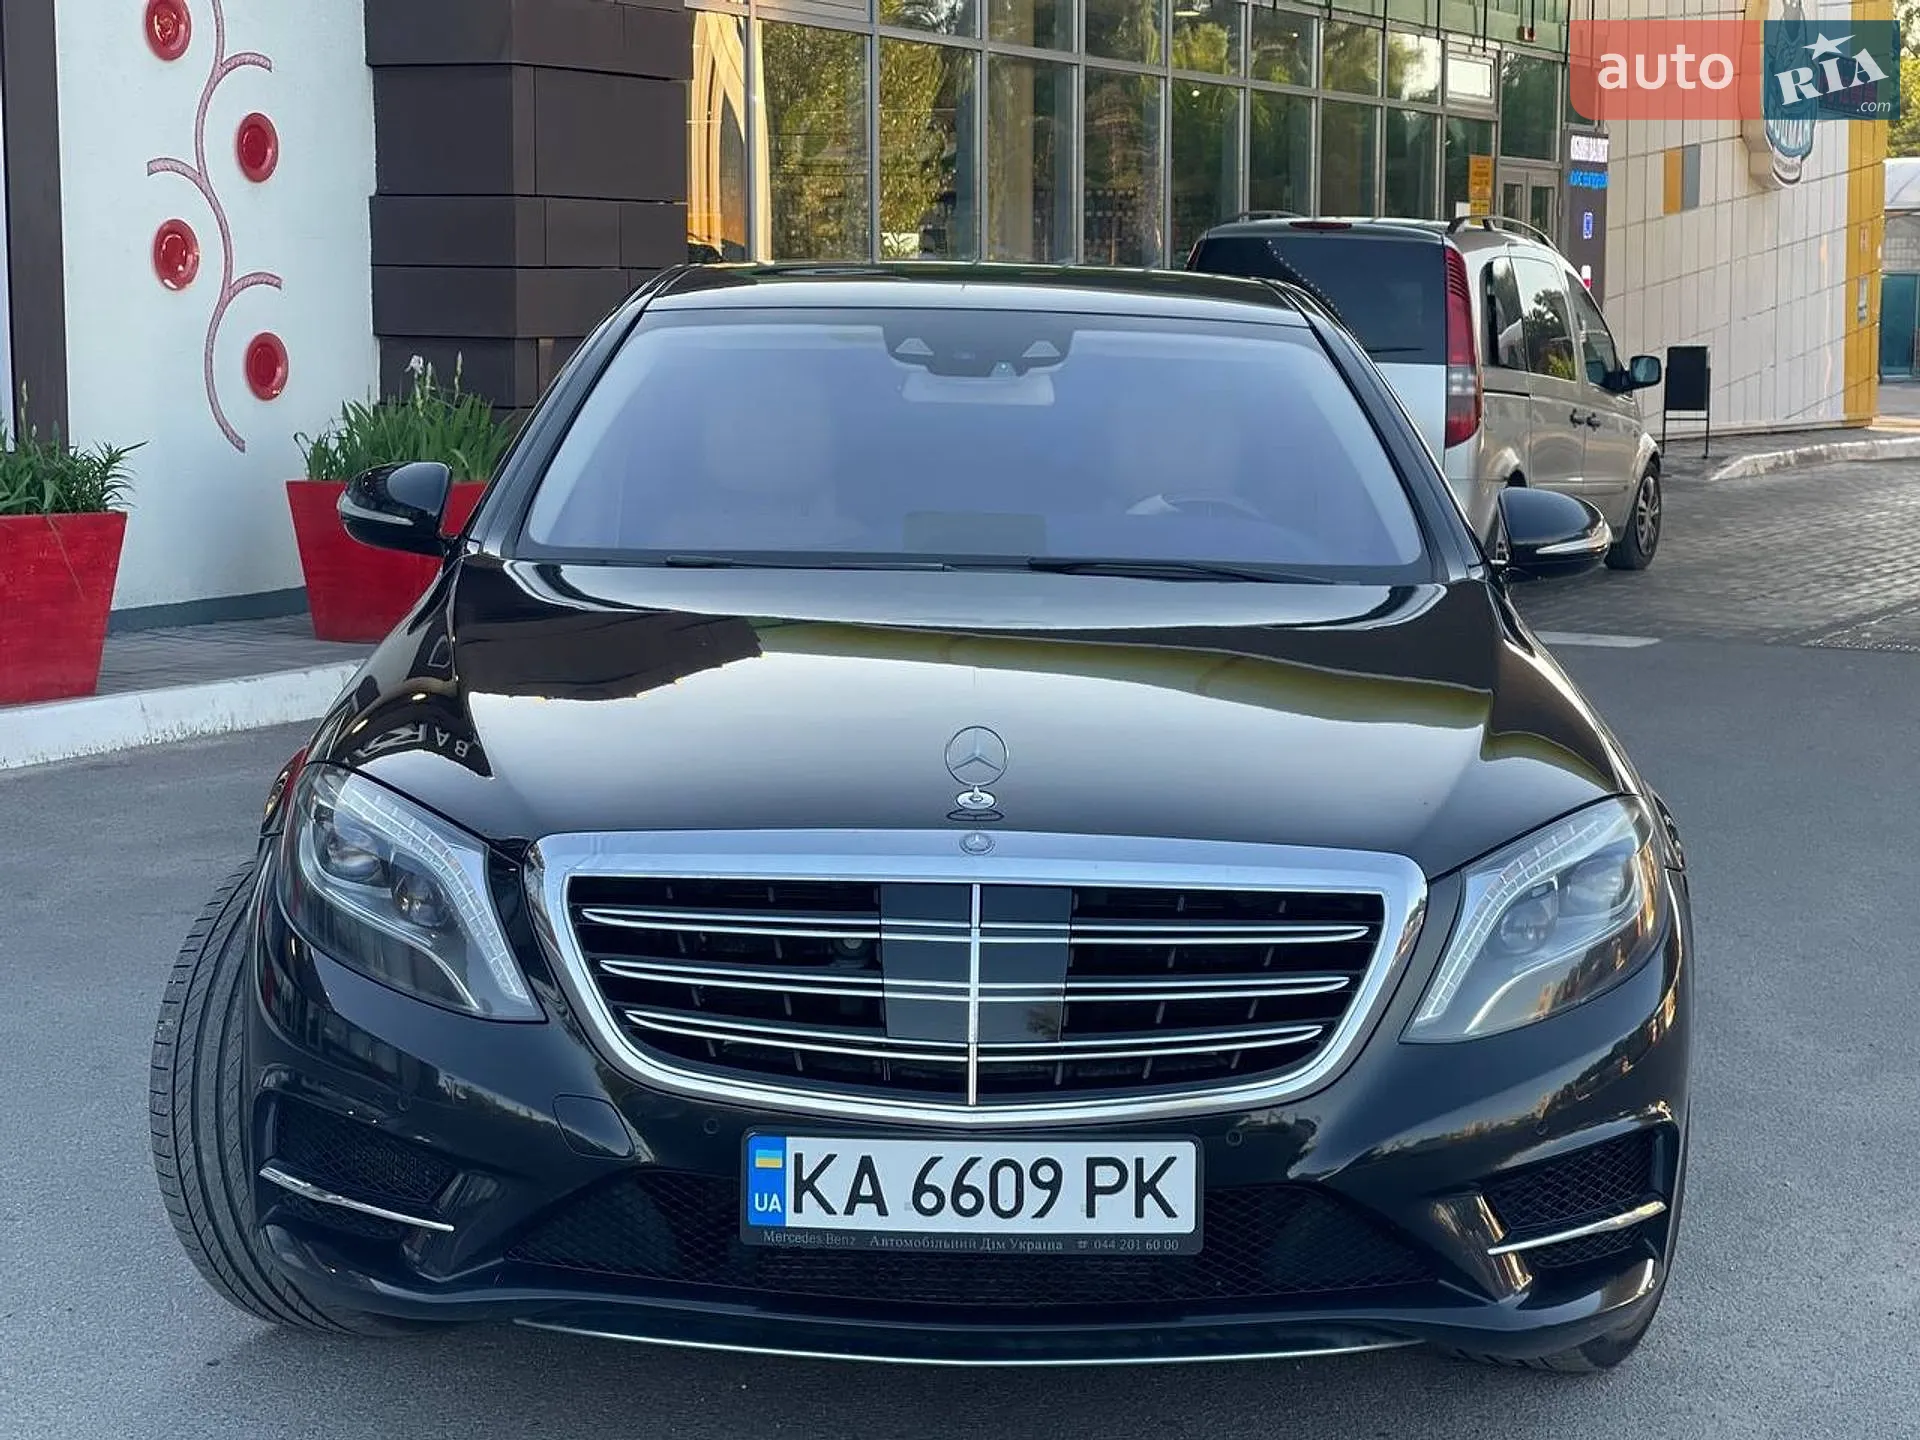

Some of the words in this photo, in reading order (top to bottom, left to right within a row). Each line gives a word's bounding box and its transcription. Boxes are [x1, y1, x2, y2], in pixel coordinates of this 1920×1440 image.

[754, 1193, 782, 1213] UA
[793, 1152, 889, 1217] KA
[911, 1155, 1063, 1219] 6609
[1085, 1156, 1179, 1219] PK
